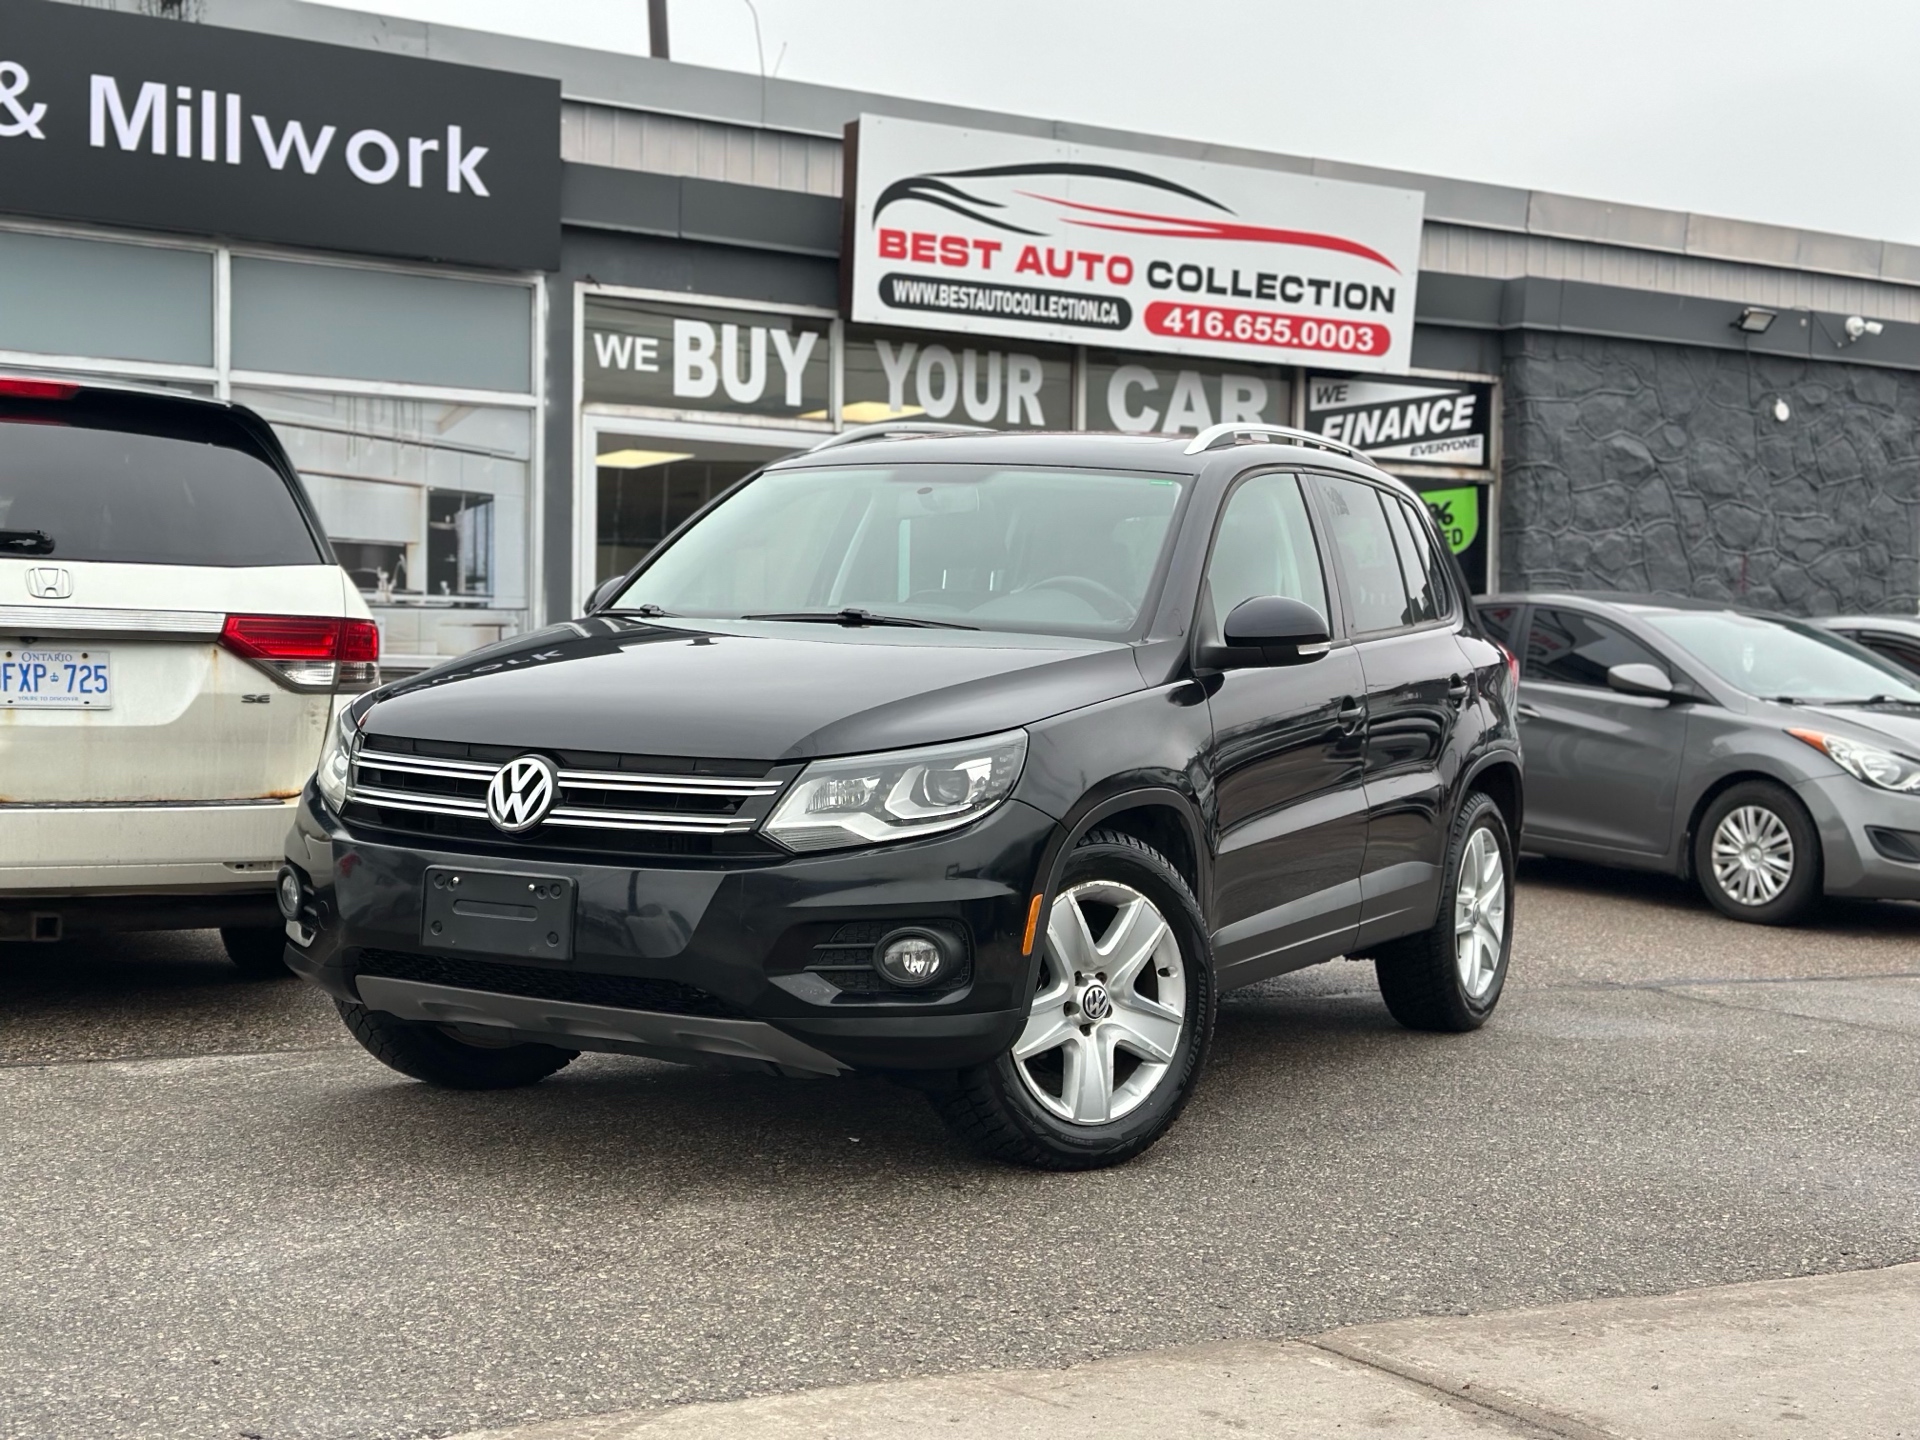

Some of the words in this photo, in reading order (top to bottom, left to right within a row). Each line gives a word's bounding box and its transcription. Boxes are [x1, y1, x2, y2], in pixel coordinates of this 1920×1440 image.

[0, 61, 47, 139] &
[89, 74, 490, 197] Millwork
[878, 228, 1001, 270] BEST
[1015, 245, 1134, 286] AUTO
[1147, 260, 1396, 314] COLLECTION
[893, 279, 1120, 325] WWW.BESTAUTOCOLLECTION.CA
[1163, 307, 1375, 352] 416.655.0003
[594, 333, 659, 373] WE
[673, 318, 819, 407] BUY
[874, 339, 1046, 427] YOUR
[1107, 364, 1270, 443] CAR
[1317, 384, 1349, 405] WE
[1321, 394, 1477, 447] FINANCE
[1410, 437, 1480, 457] EVERYONE
[0, 663, 47, 692] FXP
[64, 664, 108, 693] 725
